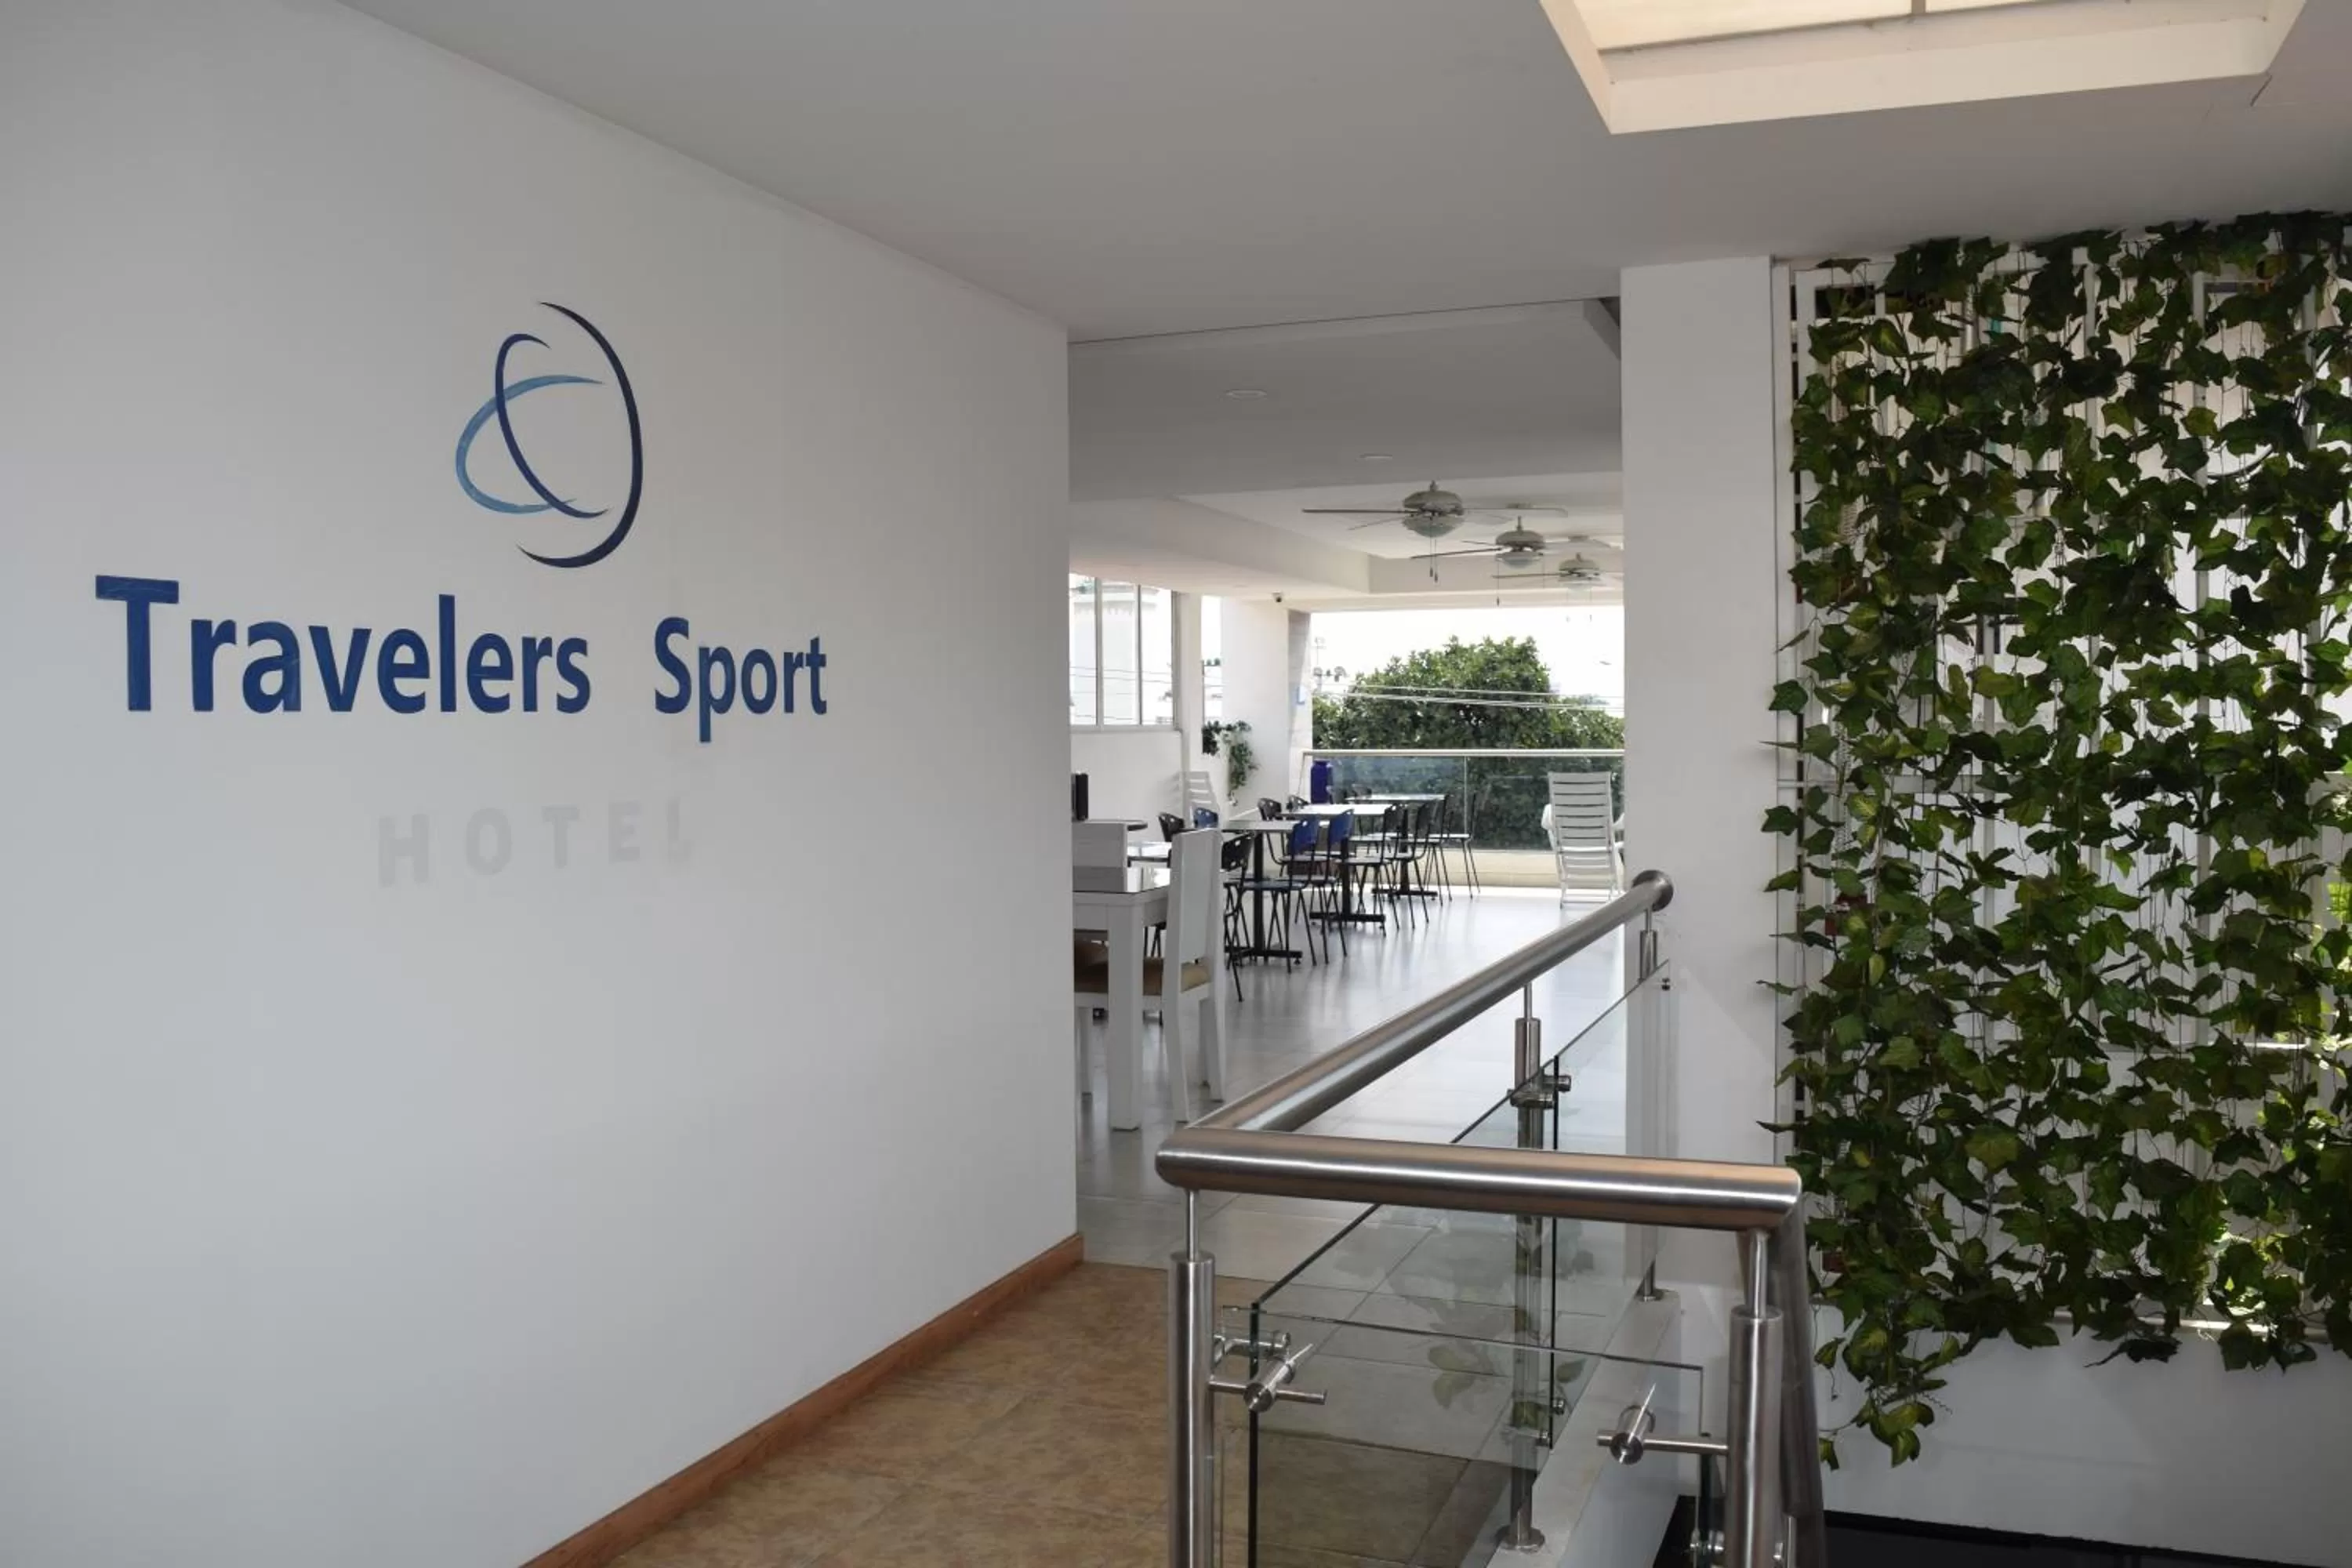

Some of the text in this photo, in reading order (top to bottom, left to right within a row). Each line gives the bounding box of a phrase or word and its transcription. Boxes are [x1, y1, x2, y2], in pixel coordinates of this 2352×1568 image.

[96, 575, 828, 743] Travelers Sport
[378, 796, 692, 887] HOTEL
